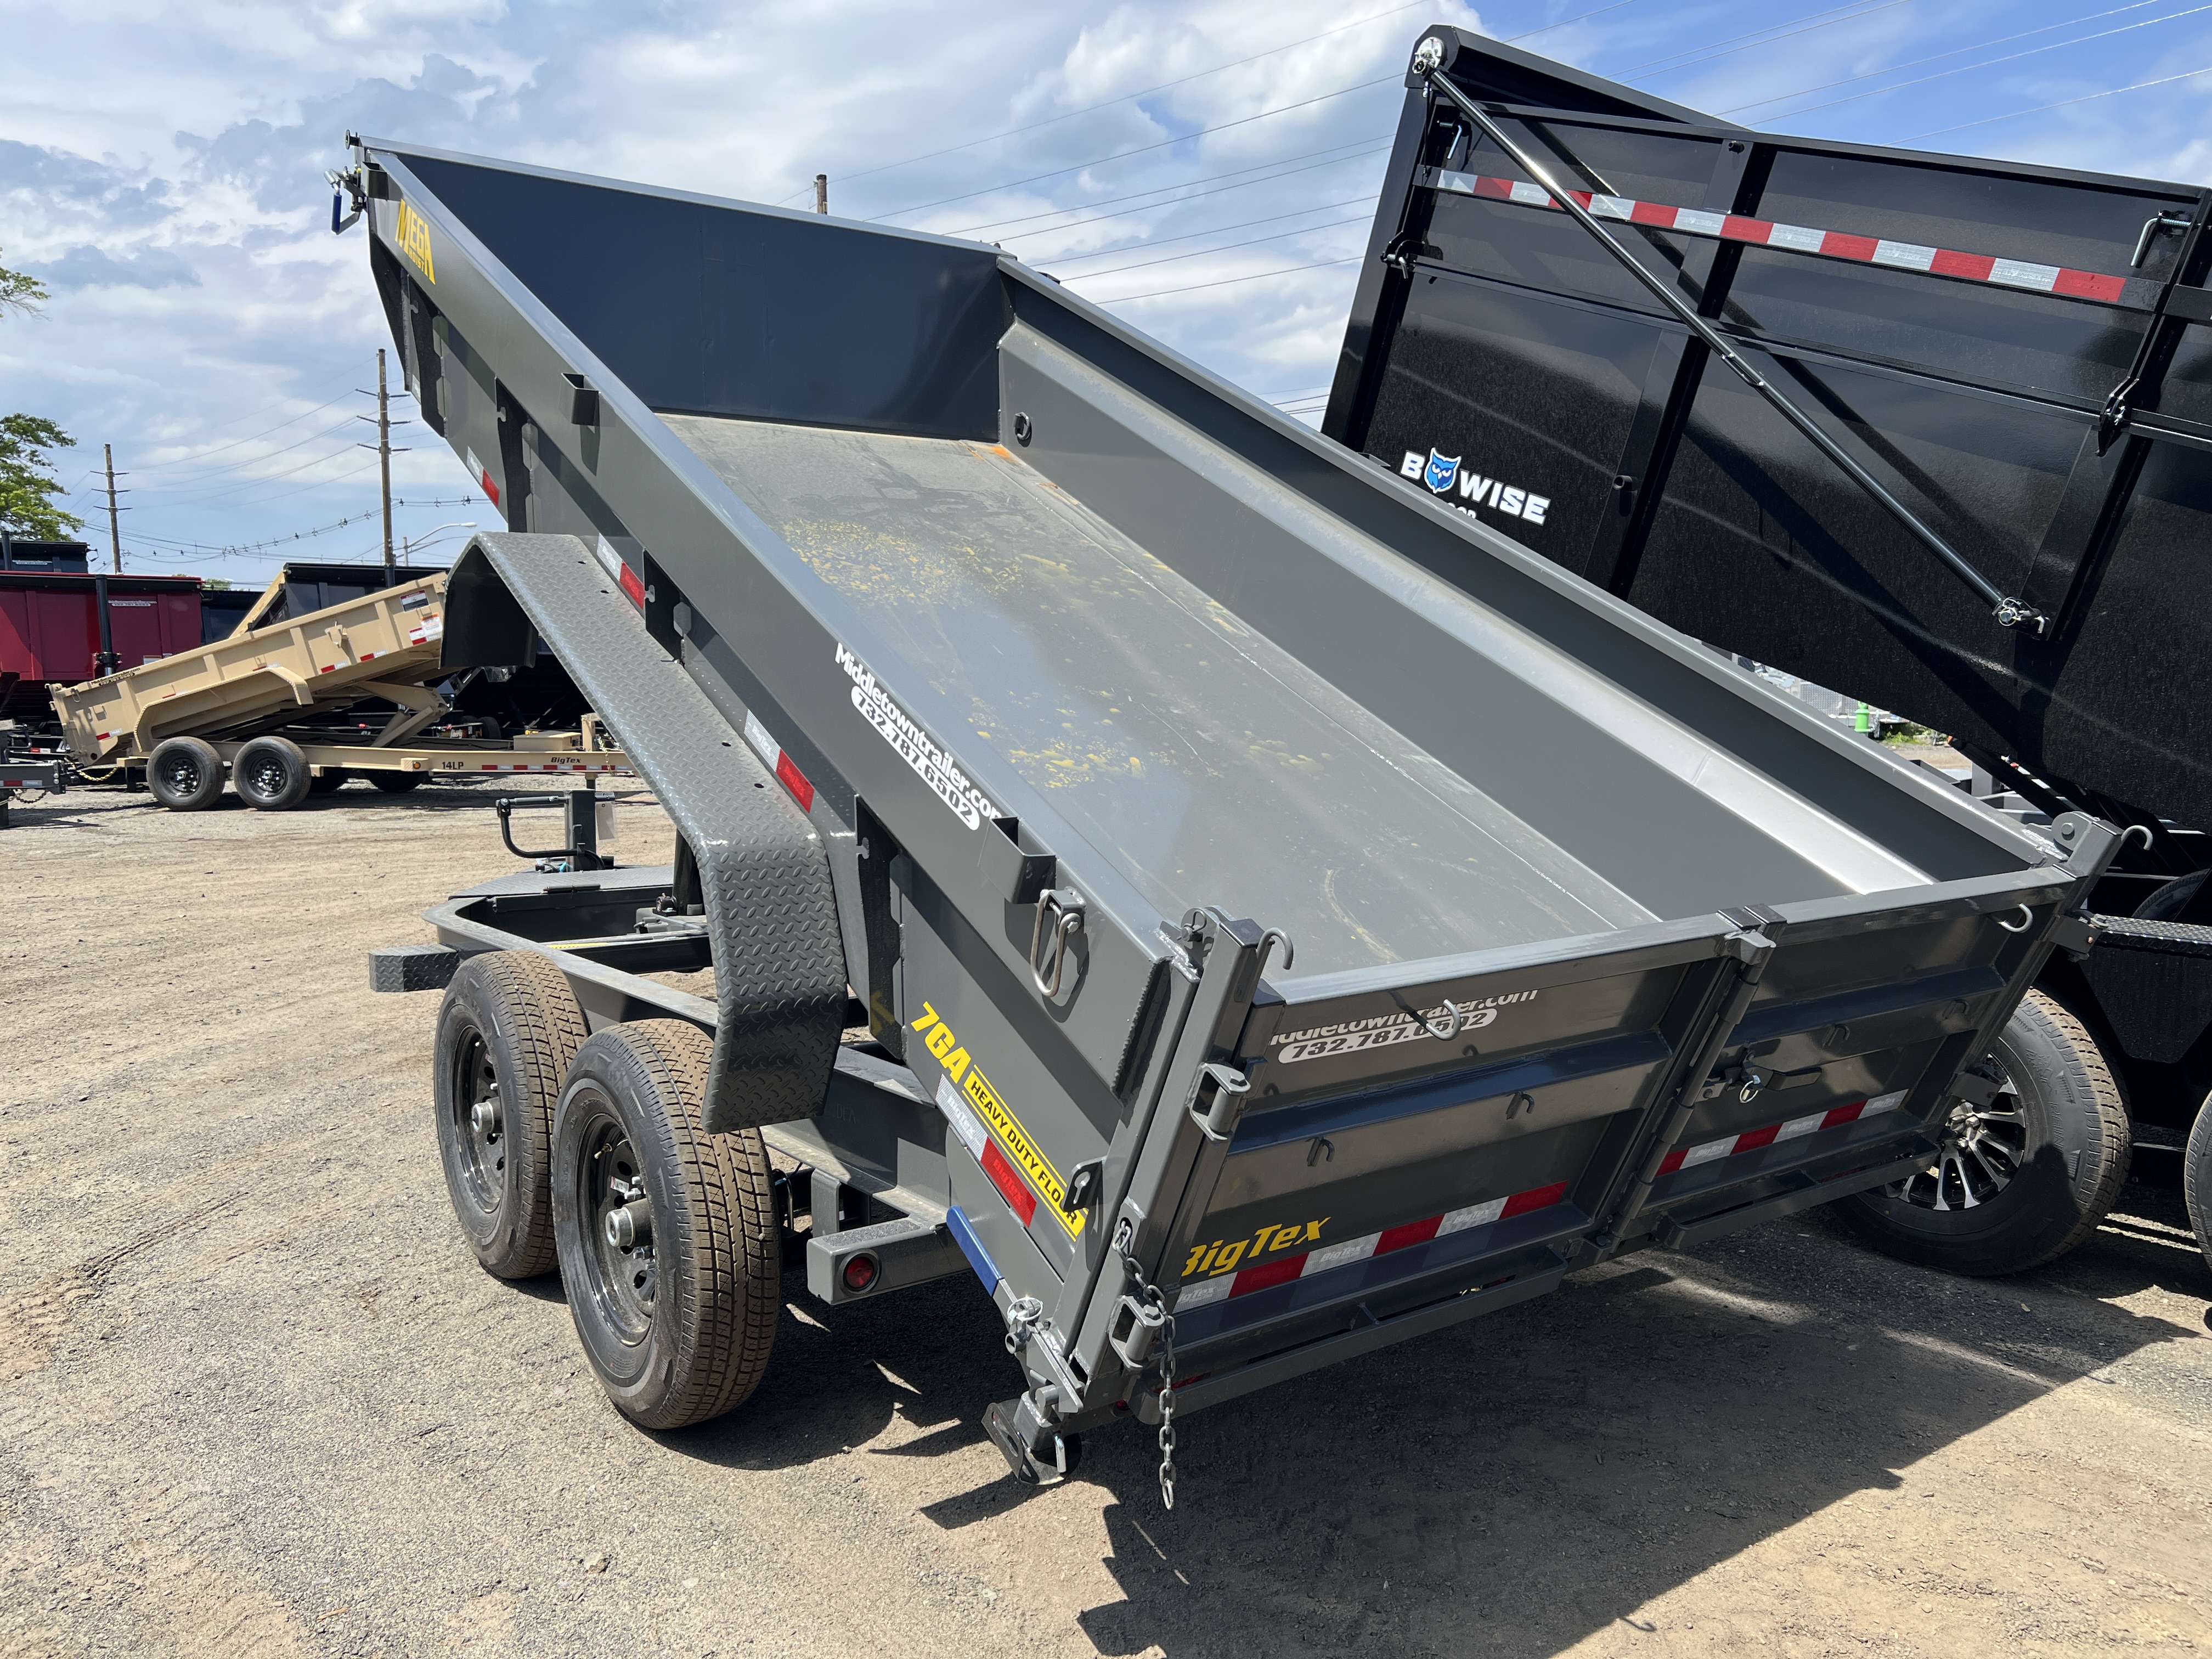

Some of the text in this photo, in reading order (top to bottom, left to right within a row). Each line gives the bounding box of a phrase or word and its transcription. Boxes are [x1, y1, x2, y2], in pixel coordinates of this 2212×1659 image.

[395, 199, 436, 285] MEGA
[408, 248, 425, 272] HOIST
[442, 761, 464, 770] 14LP
[856, 691, 974, 824] 732.787.6502
[911, 1001, 972, 1084] 7GA
[970, 1080, 1077, 1225] HEAVY DUTY FLOR
[1321, 1244, 1363, 1262] BigTex
[1178, 1286, 1216, 1304] igTex
